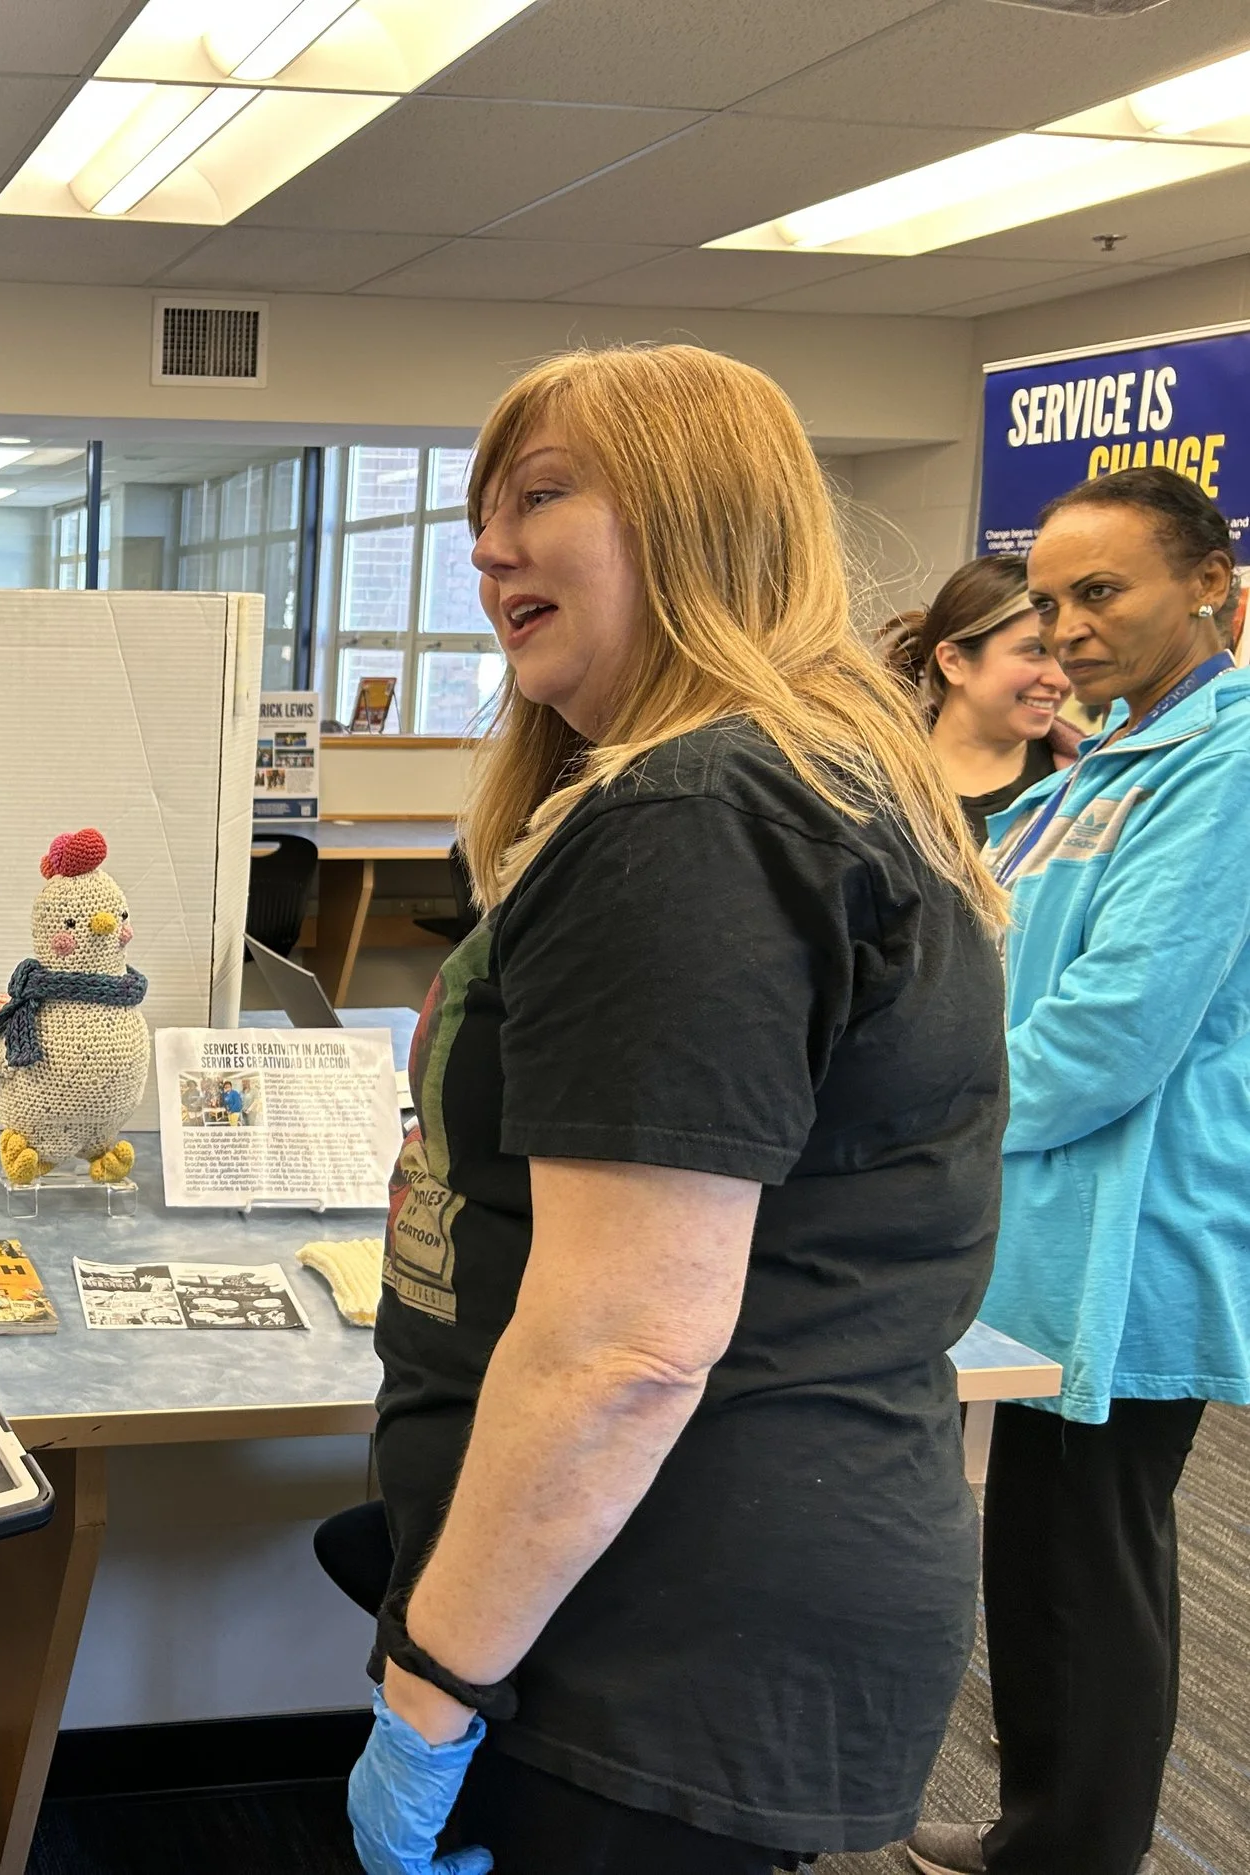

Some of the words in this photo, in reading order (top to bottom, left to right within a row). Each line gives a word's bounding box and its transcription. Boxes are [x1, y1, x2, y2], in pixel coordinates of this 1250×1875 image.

[1007, 371, 1136, 447] SERVICE
[1138, 366, 1177, 432] IS
[1230, 516, 1249, 528] and
[260, 703, 282, 718] RICK
[286, 703, 314, 718] LEWIS
[1063, 838, 1097, 850] adida
[203, 1042, 238, 1056] SERVICE
[240, 1042, 250, 1055] IS
[252, 1043, 300, 1056] CREATIVITY
[302, 1043, 311, 1056] IN
[314, 1043, 346, 1056] ACTION
[200, 1057, 232, 1068] SERVIR
[234, 1057, 244, 1068] ES
[246, 1057, 302, 1068] CREATIVIDAD
[305, 1057, 316, 1069] EN
[397, 1219, 441, 1248] CARTOON
